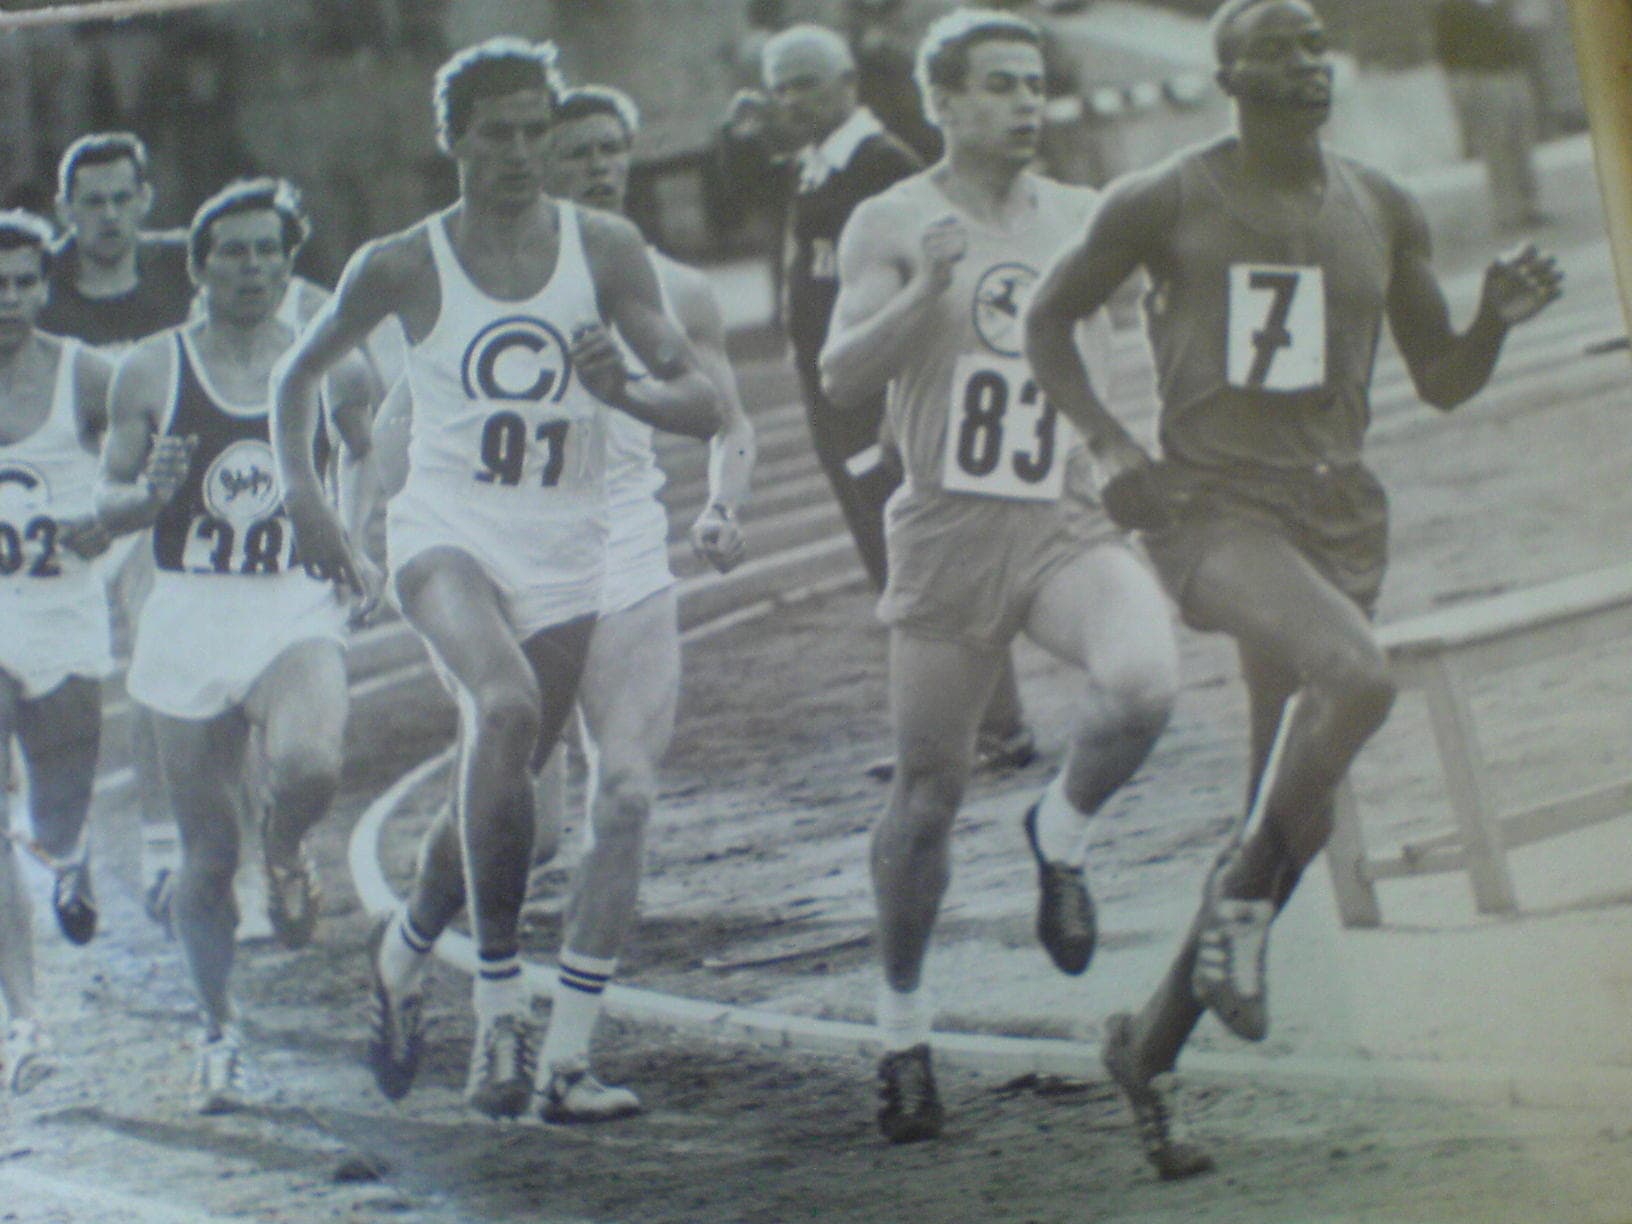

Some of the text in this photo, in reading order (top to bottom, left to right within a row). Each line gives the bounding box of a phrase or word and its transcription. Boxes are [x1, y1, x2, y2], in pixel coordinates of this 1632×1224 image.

[1248, 271, 1301, 385] 7
[474, 411, 570, 487] 91
[958, 370, 1056, 484] 83
